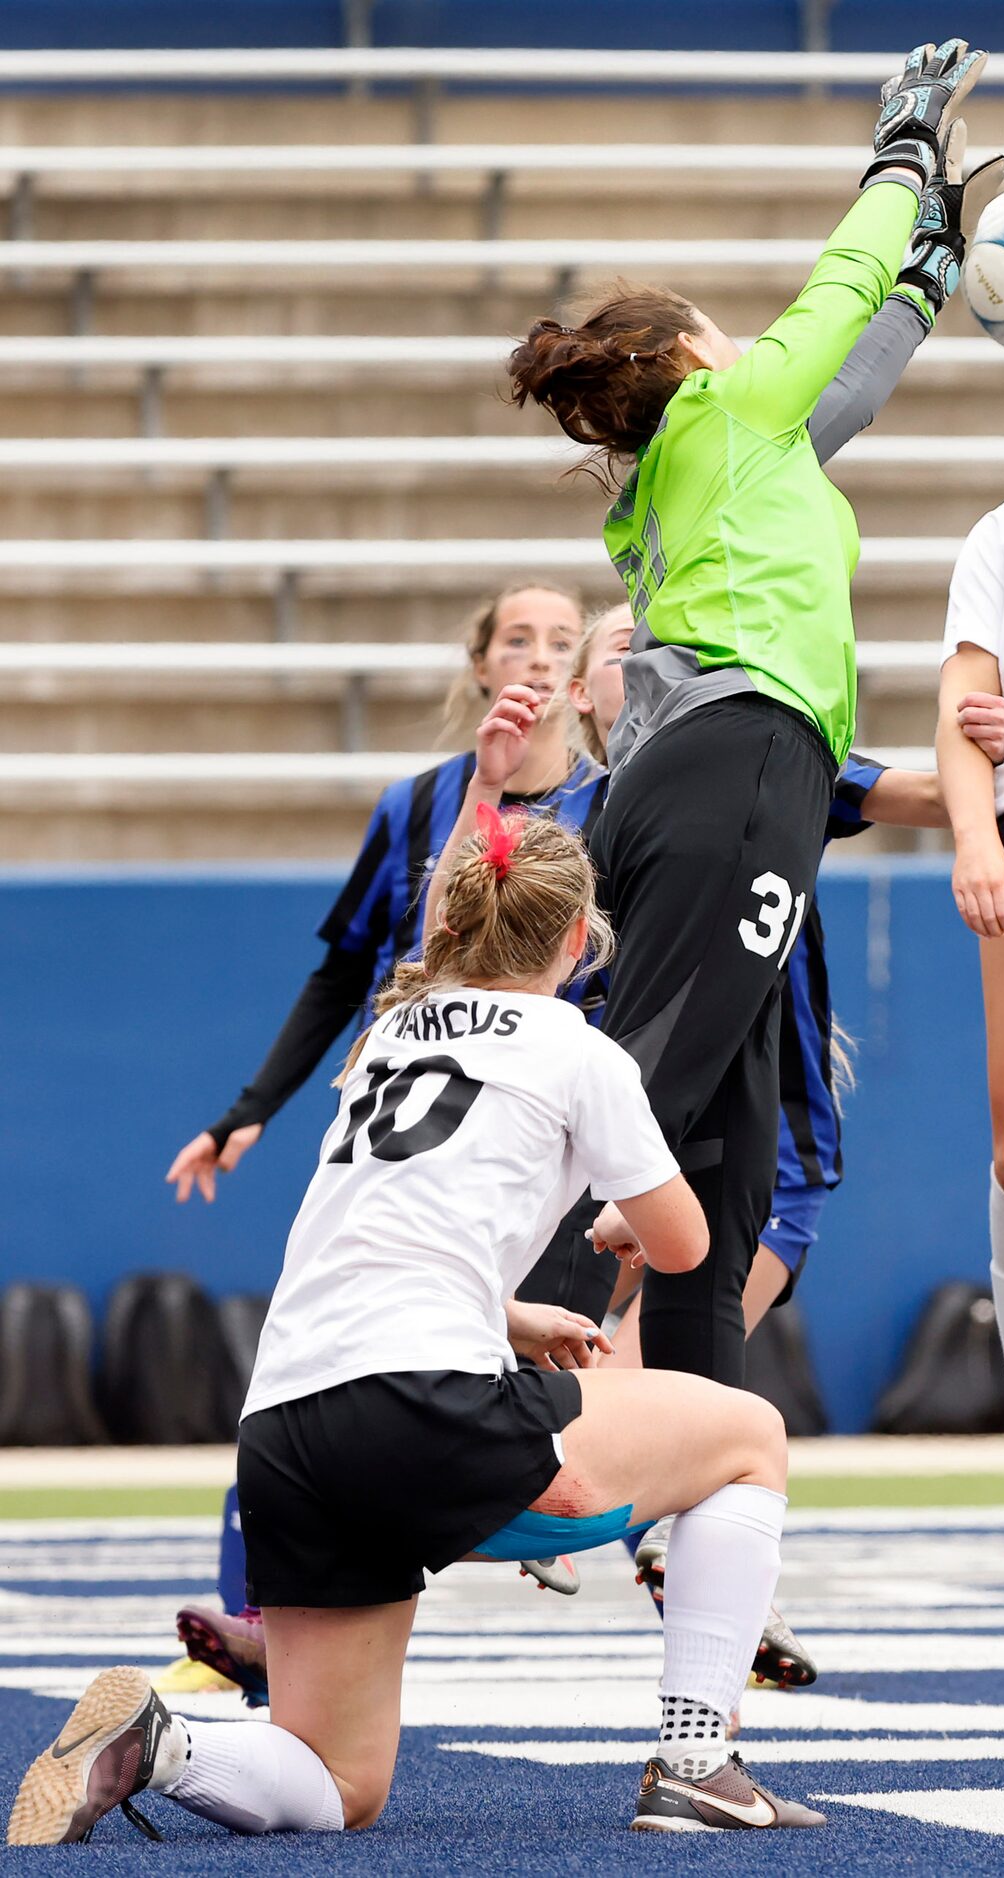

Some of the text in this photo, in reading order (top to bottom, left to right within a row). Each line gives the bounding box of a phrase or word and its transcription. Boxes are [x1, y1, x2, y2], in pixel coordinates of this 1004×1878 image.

[737, 870, 806, 971] 31
[382, 1000, 522, 1041] MARCUS
[327, 1054, 484, 1164] 10
